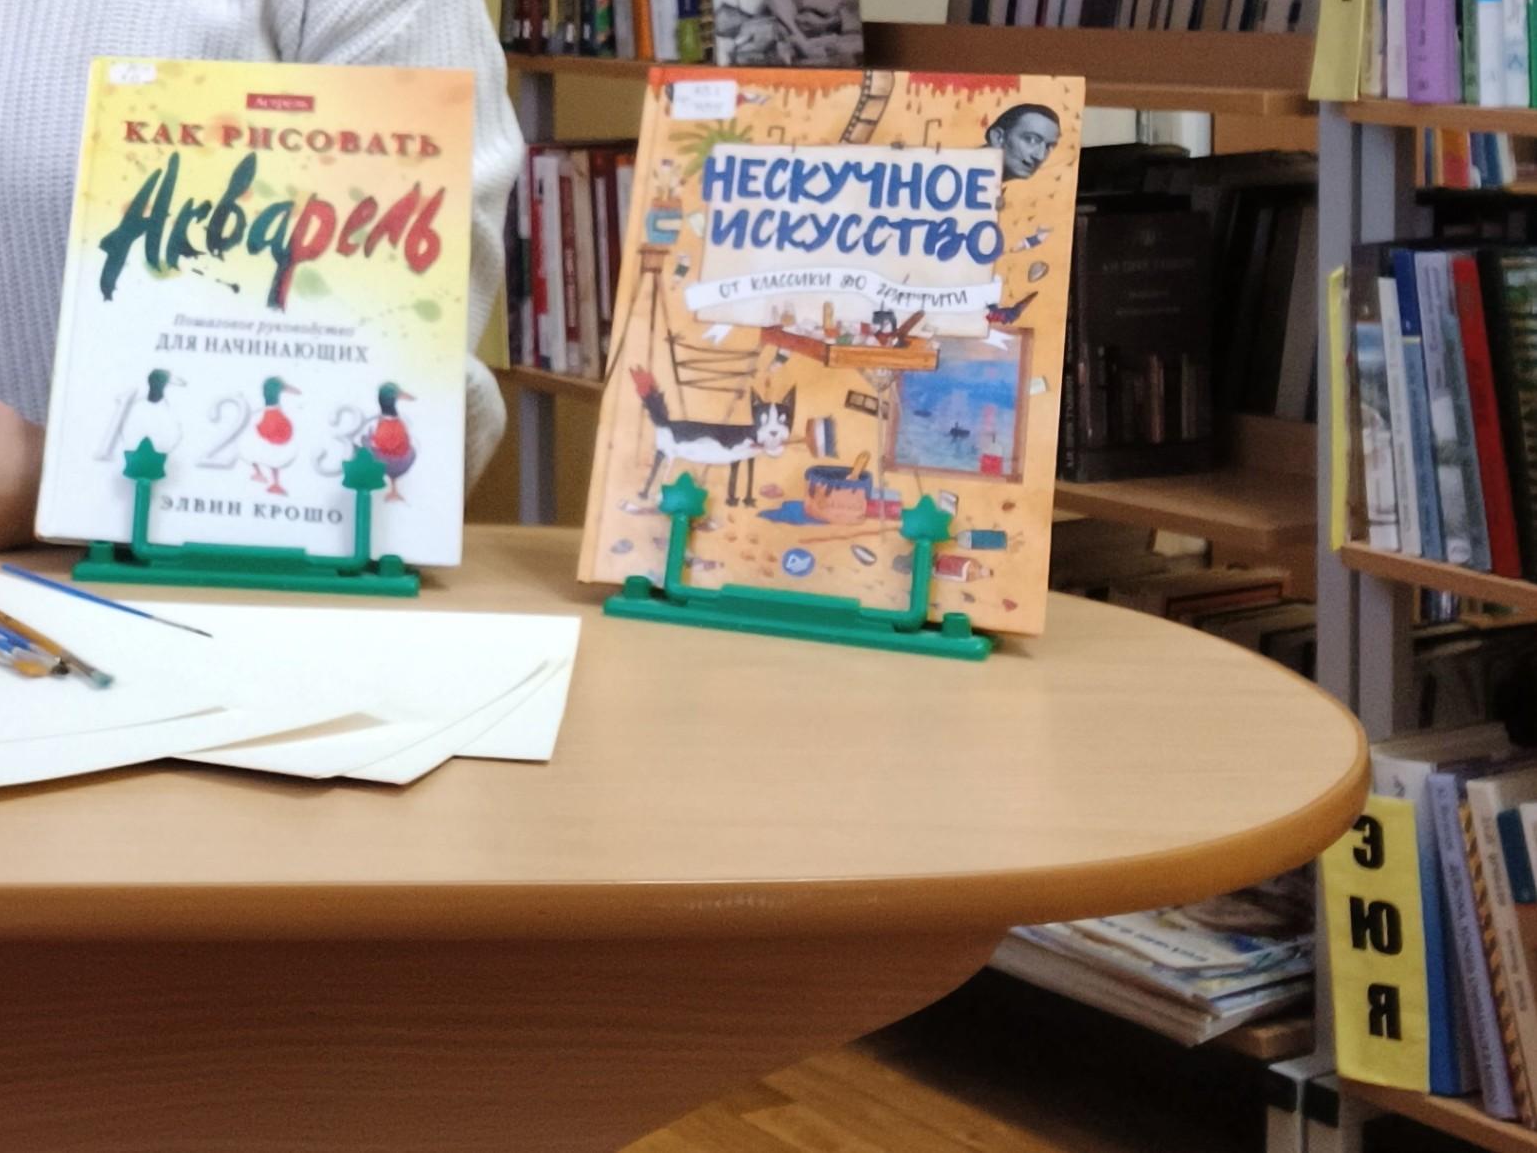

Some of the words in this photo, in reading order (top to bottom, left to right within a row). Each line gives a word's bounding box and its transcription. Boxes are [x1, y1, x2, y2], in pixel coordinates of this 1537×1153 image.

[124, 121, 204, 146] КАК
[221, 125, 441, 157] РИСОВАТЬ
[702, 155, 996, 211] НЕСКУЧНОЕ
[100, 151, 446, 312] Акварель
[712, 208, 1004, 265] ИСКУССТВО
[719, 281, 739, 299] ОТ
[751, 271, 832, 292] КЛАССИКИ
[840, 274, 866, 290] ДО
[155, 333, 197, 352] ДЛЯ
[205, 337, 368, 363] НАЧИНАЮЩИХ
[174, 314, 253, 330] Пошаговое
[256, 319, 355, 338] руководство
[196, 396, 252, 469] 2
[160, 495, 243, 516] ЭЛВИН
[253, 503, 344, 524] КРОШО
[1352, 814, 1385, 869] Э
[1349, 895, 1403, 955] Ю
[1367, 983, 1402, 1041] Я
